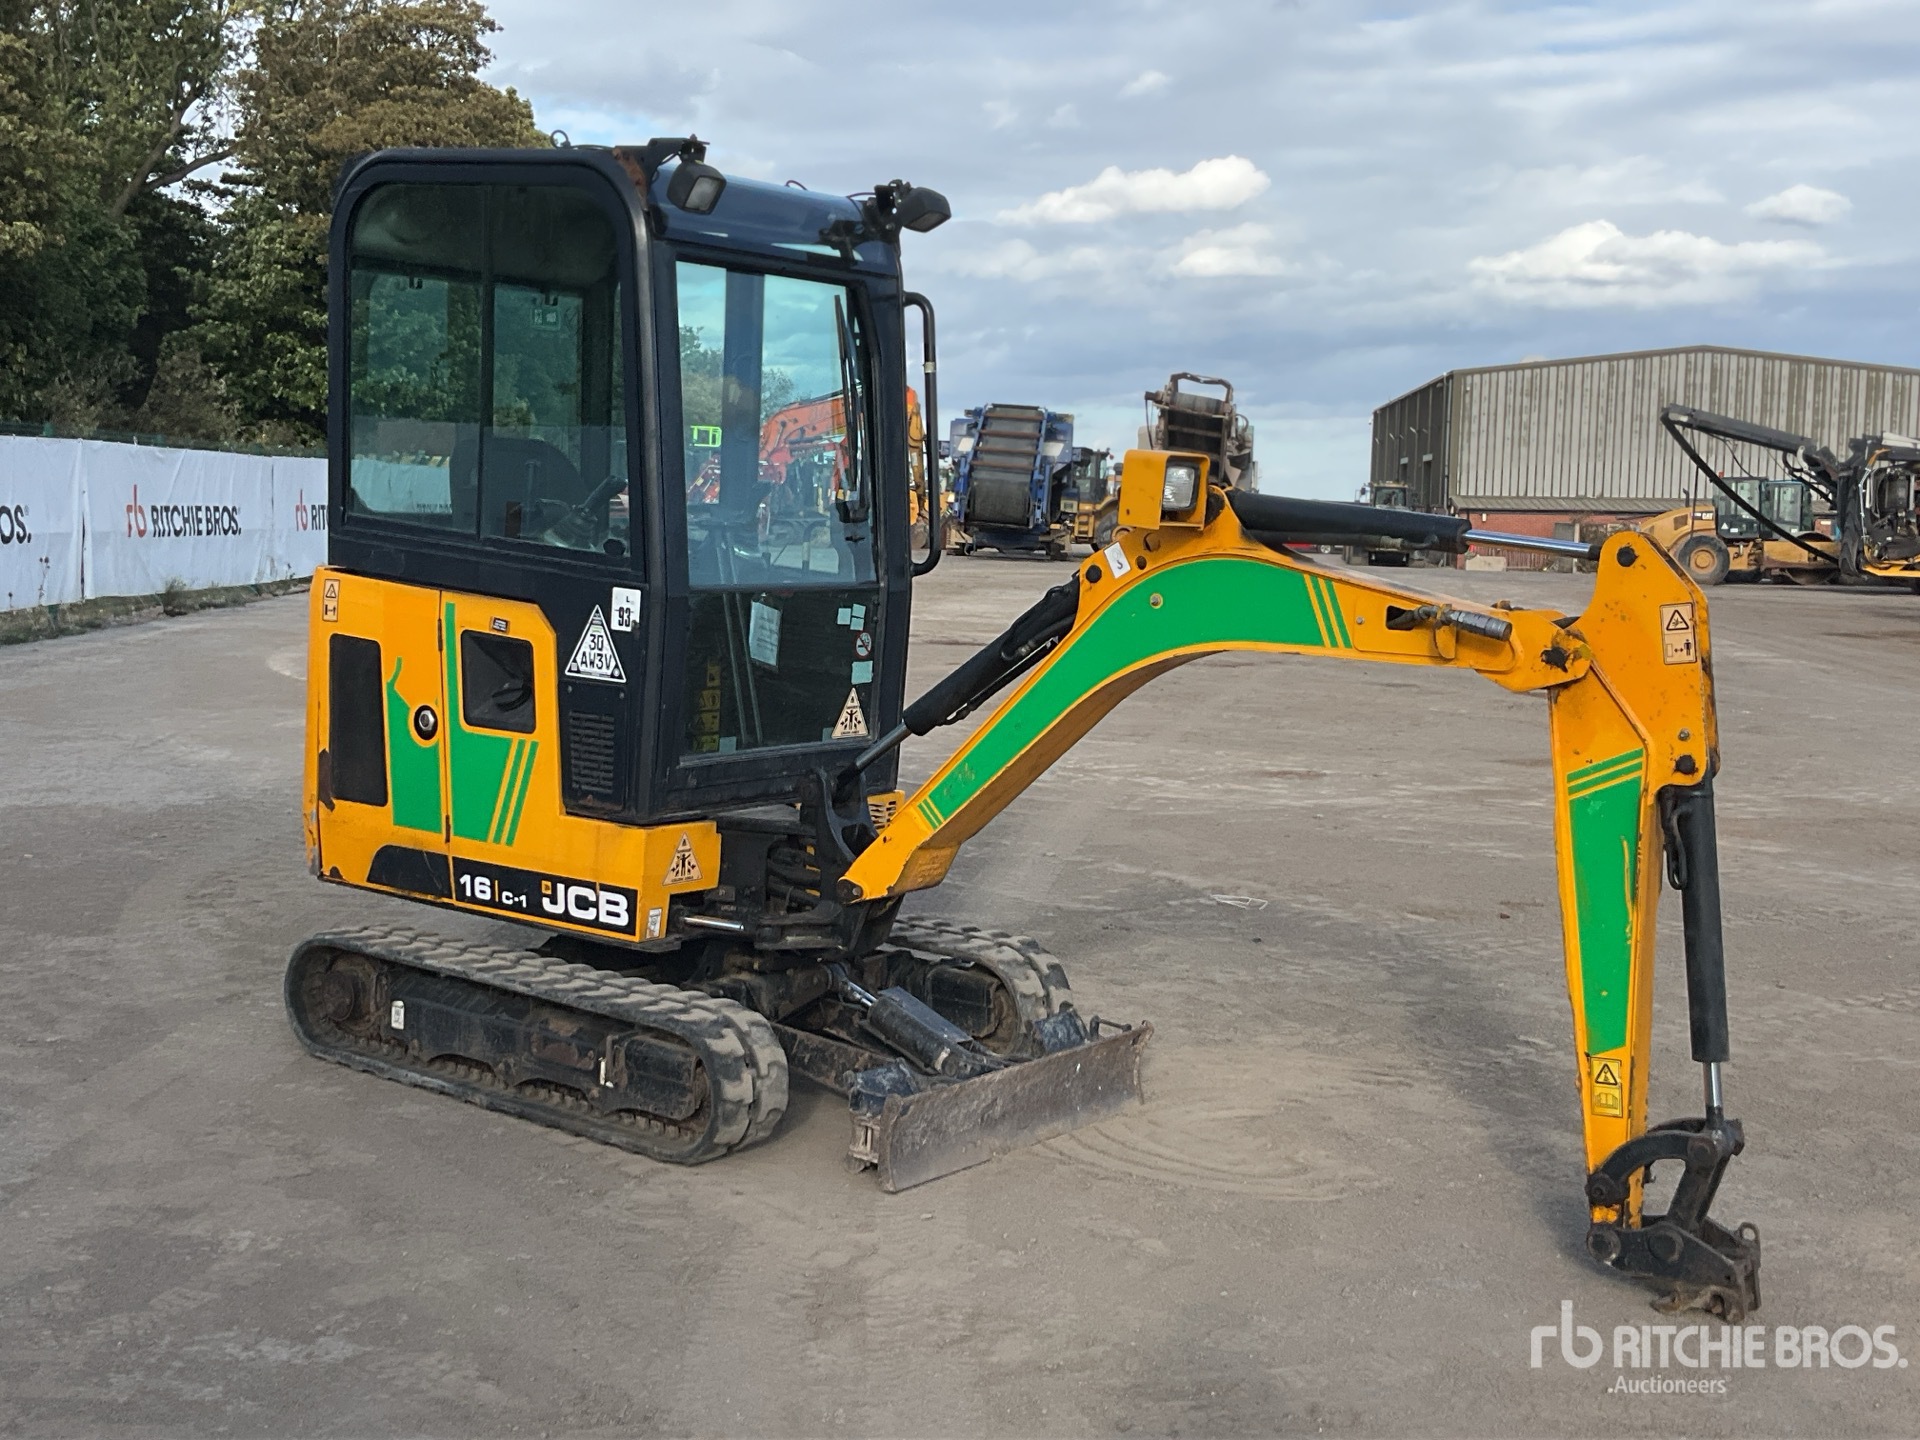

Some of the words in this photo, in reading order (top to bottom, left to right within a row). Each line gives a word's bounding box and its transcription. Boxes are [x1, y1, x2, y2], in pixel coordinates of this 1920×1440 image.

[151, 505, 203, 537] RITCHIE
[205, 505, 242, 536] BROS.
[311, 505, 328, 530] RIT
[618, 607, 631, 627] 93
[459, 874, 492, 900] 16
[541, 882, 629, 927] JCB
